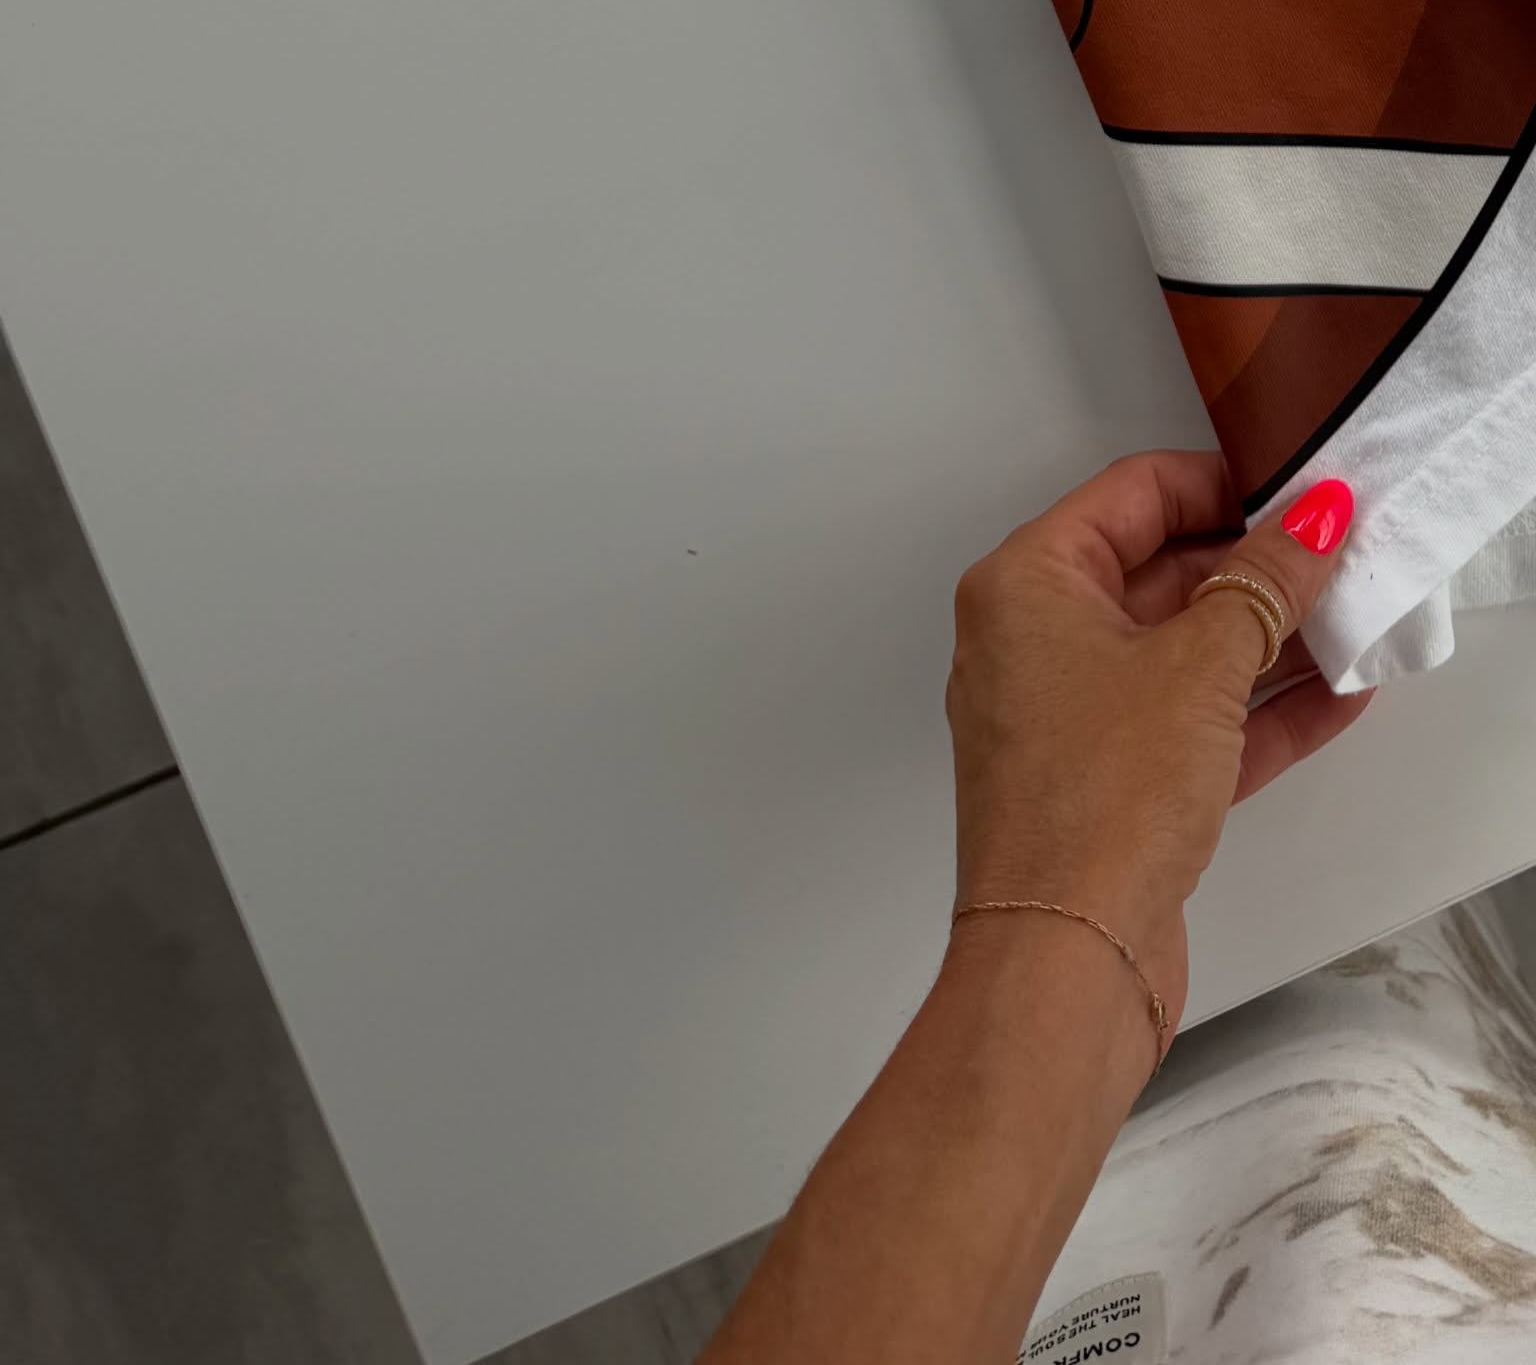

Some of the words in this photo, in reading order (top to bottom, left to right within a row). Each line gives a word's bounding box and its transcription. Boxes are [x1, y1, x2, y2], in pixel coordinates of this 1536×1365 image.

[1071, 1294, 1141, 1325] NURTURE
[1102, 1305, 1141, 1324] HEAL
[1069, 1320, 1097, 1339] THE
[1028, 1333, 1066, 1359] SOUL
